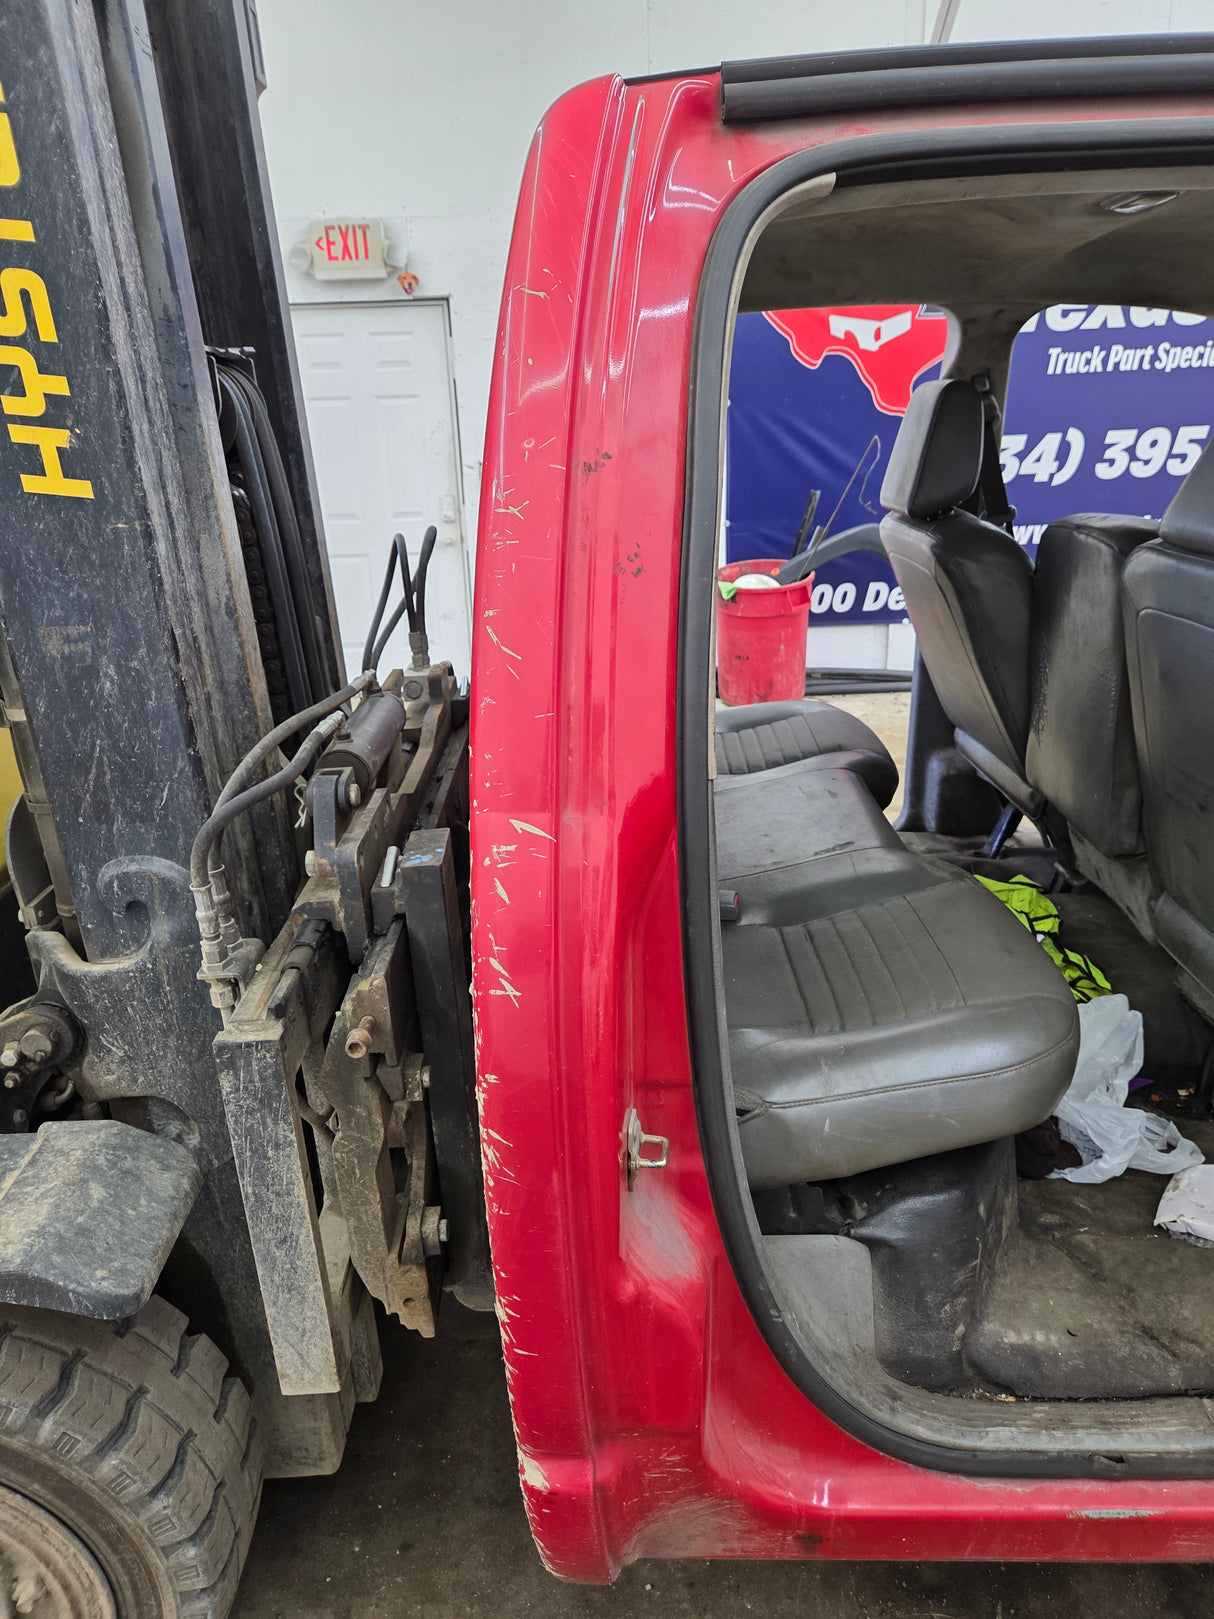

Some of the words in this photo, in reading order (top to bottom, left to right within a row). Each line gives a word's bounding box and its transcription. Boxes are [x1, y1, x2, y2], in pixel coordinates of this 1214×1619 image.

[324, 224, 370, 262] EXIT
[1046, 345, 1107, 375] Truck
[1106, 344, 1154, 372] Part
[862, 581, 908, 612] De
